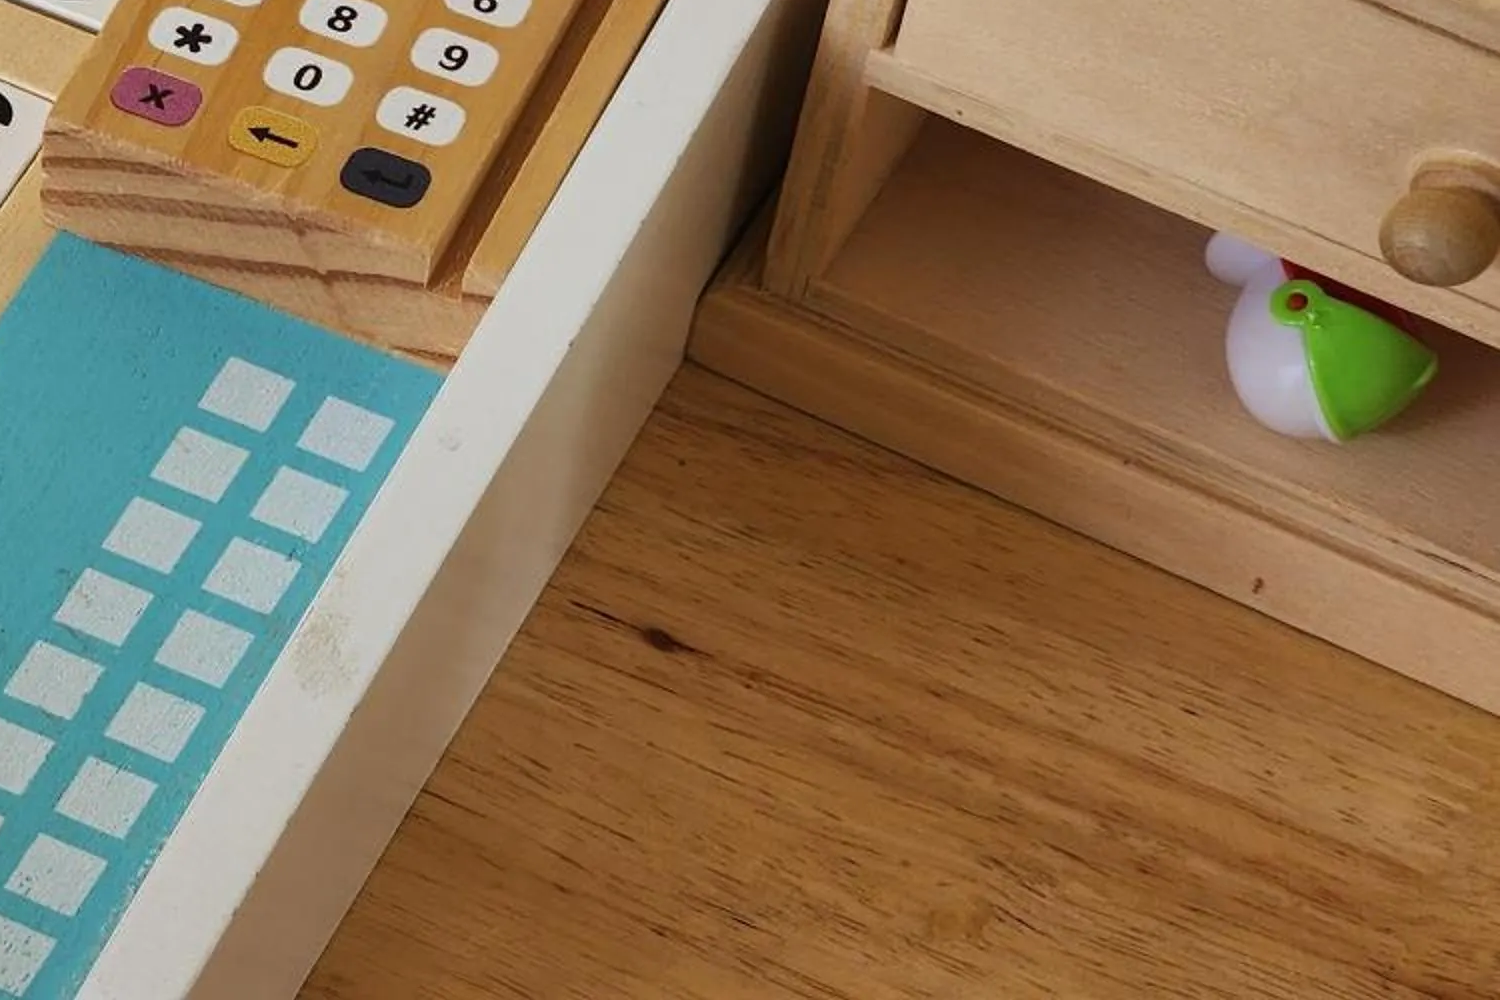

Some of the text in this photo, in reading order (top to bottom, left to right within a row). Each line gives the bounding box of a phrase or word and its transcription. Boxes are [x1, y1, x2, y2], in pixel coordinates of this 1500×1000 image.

[326, 5, 358, 34] 8
[437, 45, 469, 72] 9
[292, 64, 324, 92] 0
